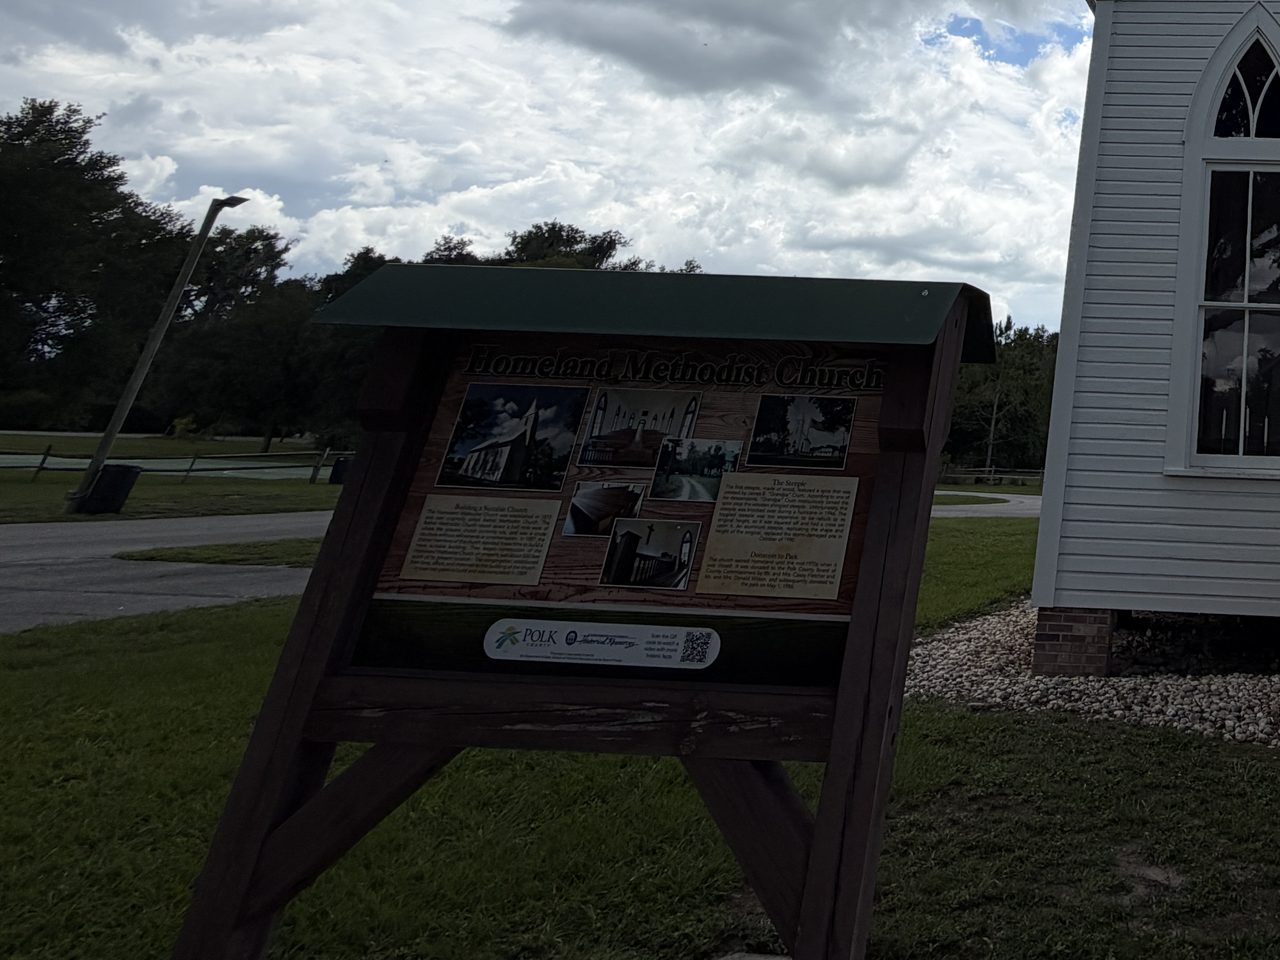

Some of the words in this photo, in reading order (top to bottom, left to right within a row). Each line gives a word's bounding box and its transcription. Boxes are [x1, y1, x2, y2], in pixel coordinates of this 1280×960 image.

[464, 345, 614, 379] Homeland
[620, 349, 767, 385] Methodist
[775, 355, 882, 390] Church
[523, 628, 557, 644] POLK
